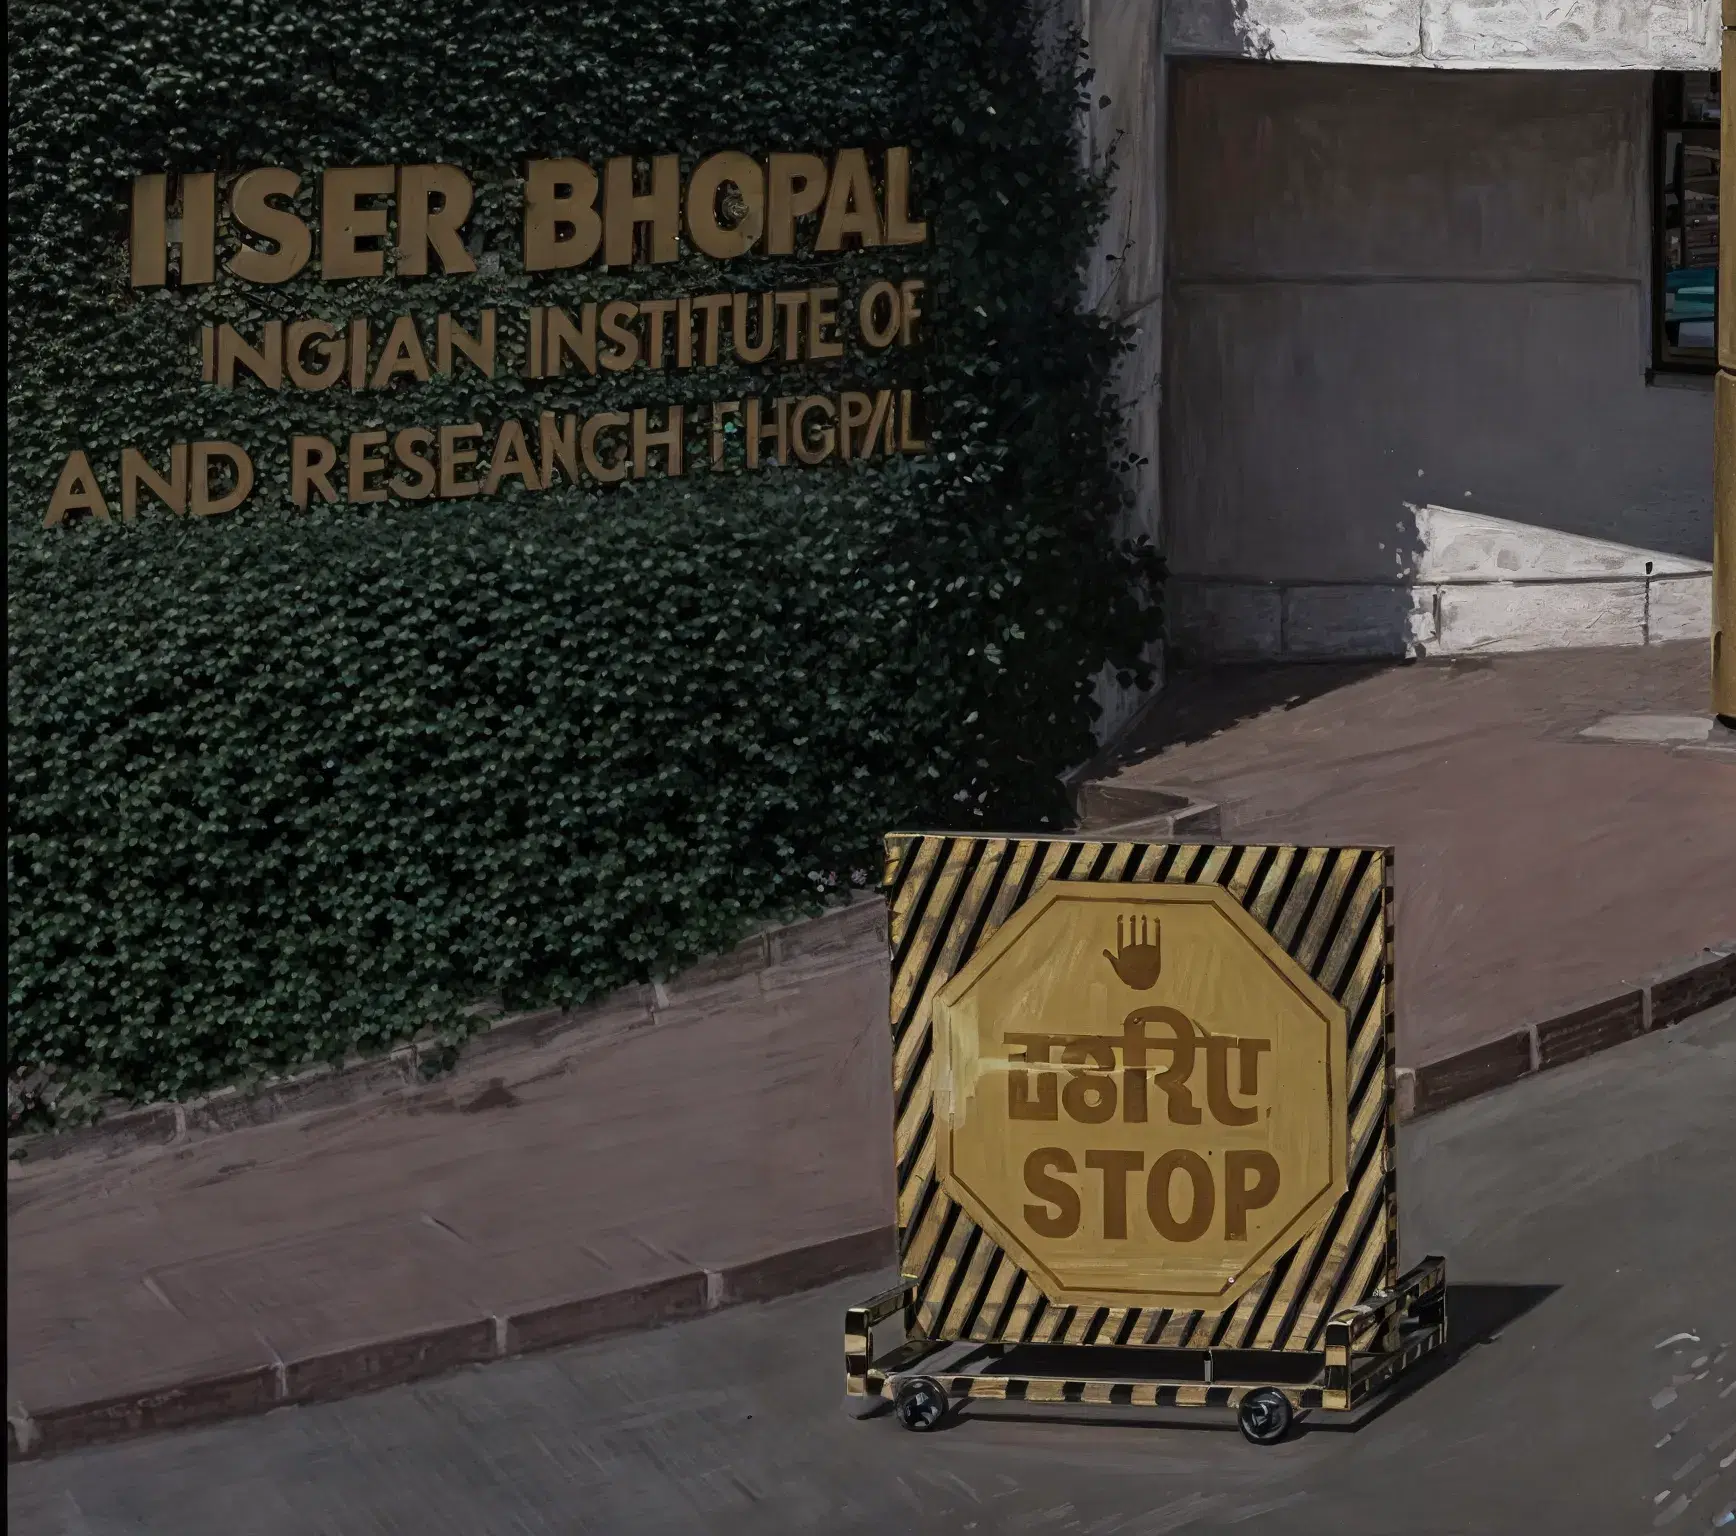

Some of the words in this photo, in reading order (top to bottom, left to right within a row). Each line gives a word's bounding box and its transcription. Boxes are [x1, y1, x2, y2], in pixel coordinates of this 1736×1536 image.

[524, 146, 928, 273] BHOPAL
[527, 286, 844, 378] INSTITUTE
[859, 279, 926, 348] OF
[42, 441, 256, 529] AND
[1023, 1146, 1281, 1243] STOP
